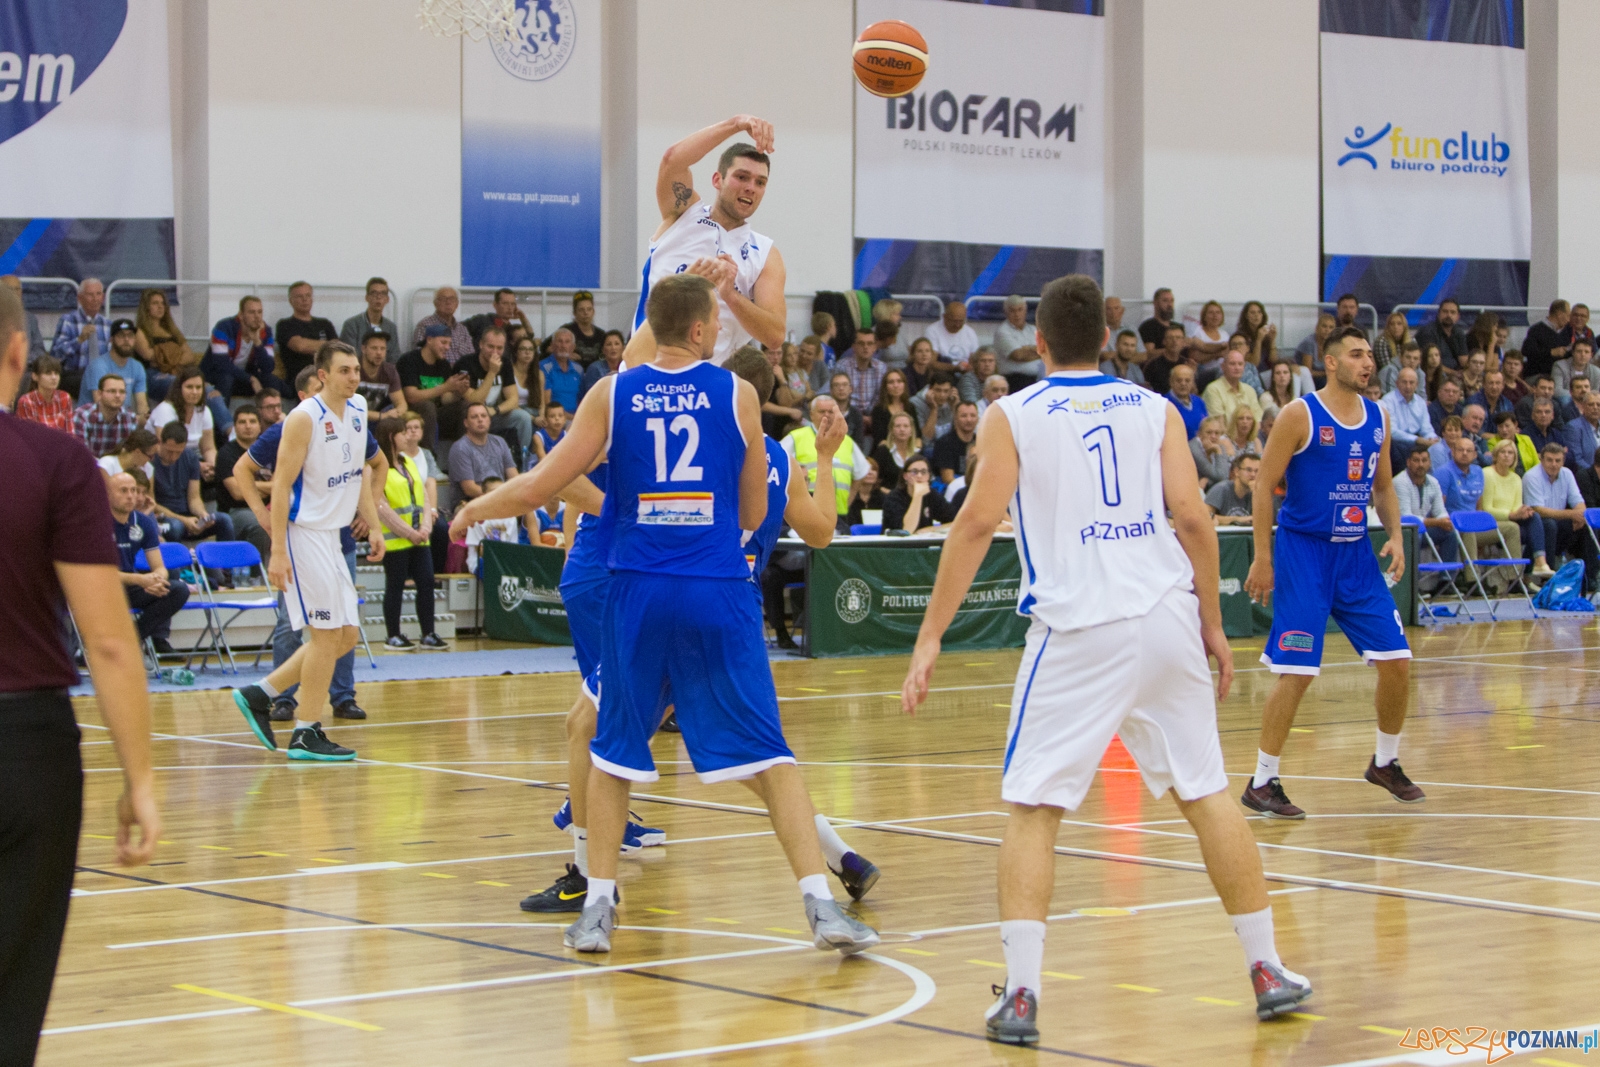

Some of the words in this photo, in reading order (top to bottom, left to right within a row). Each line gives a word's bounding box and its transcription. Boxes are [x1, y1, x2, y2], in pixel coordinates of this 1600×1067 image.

[867, 54, 912, 71] molten
[0, 51, 75, 103] em
[886, 88, 1077, 143] BIOFARM
[903, 138, 946, 151] POLSKI
[950, 141, 1016, 157] PRODUCENT
[1020, 146, 1062, 160] LEKÓW
[1389, 126, 1511, 163] funclub
[1390, 158, 1435, 172] biuro
[1441, 161, 1508, 177] podróży
[482, 191, 580, 206] www.azs.put.poznan.pl
[645, 383, 697, 395] GALERIA
[1071, 392, 1142, 411] funclub
[645, 413, 704, 483] 12
[1328, 491, 1370, 501] INOWROCŁA
[683, 515, 712, 523] MIASTO
[882, 594, 932, 608] POLITECH
